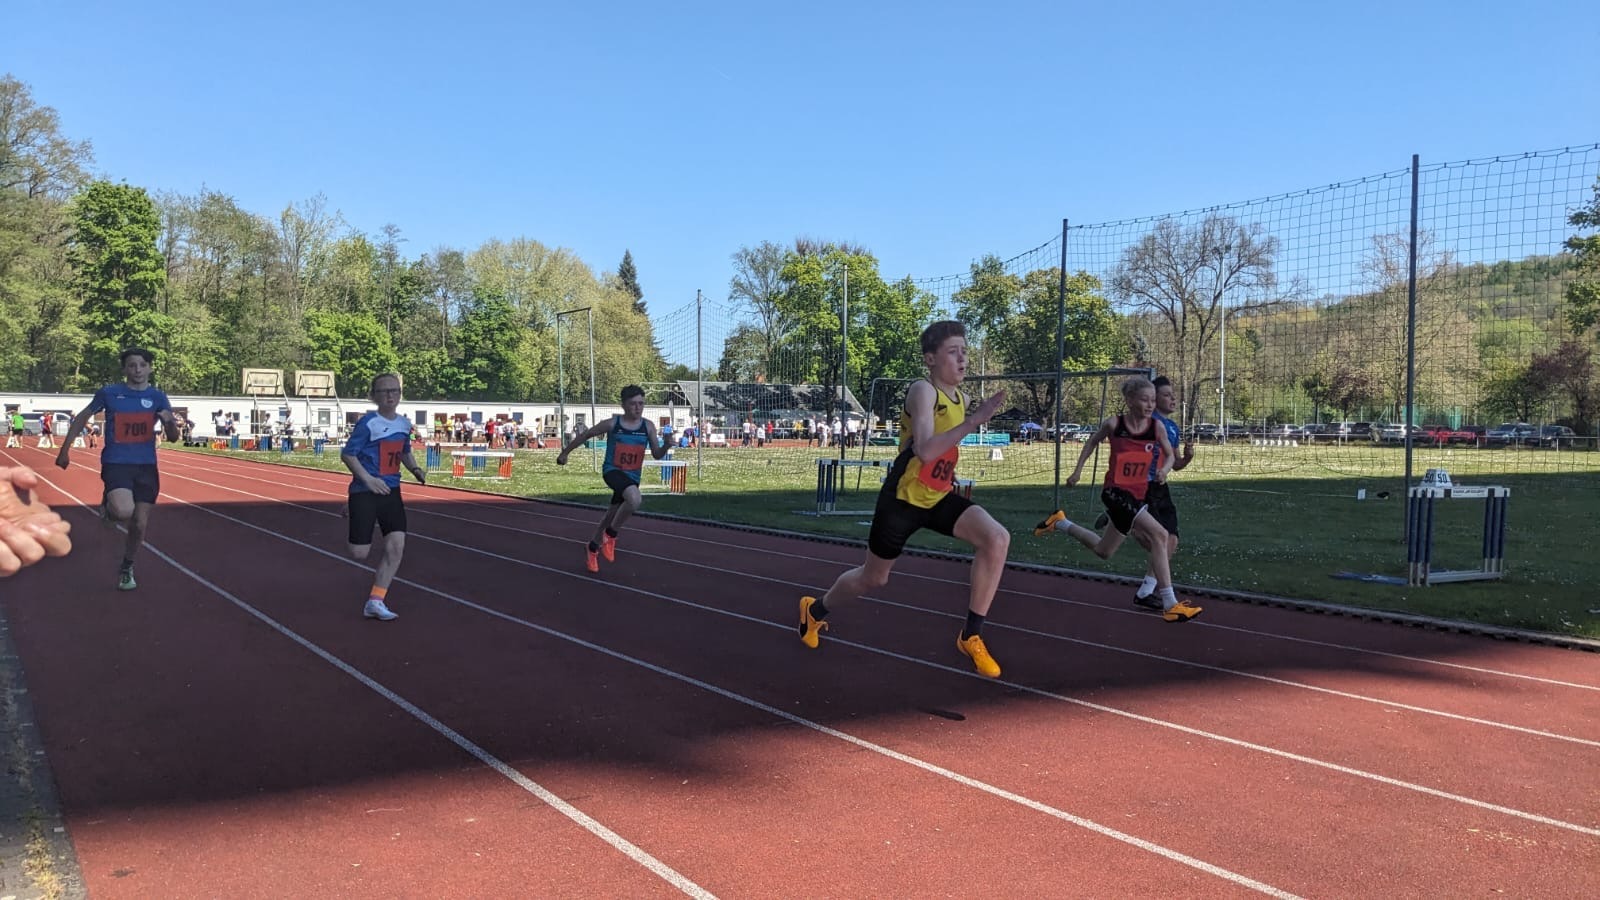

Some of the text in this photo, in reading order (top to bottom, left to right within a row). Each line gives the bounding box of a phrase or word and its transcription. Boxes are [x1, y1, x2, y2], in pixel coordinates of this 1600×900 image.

[124, 422, 146, 436] 700
[620, 453, 637, 465] 631
[930, 460, 953, 480] 69
[1123, 462, 1146, 477] 677
[1424, 473, 1434, 483] 50
[1438, 474, 1448, 483] 50
